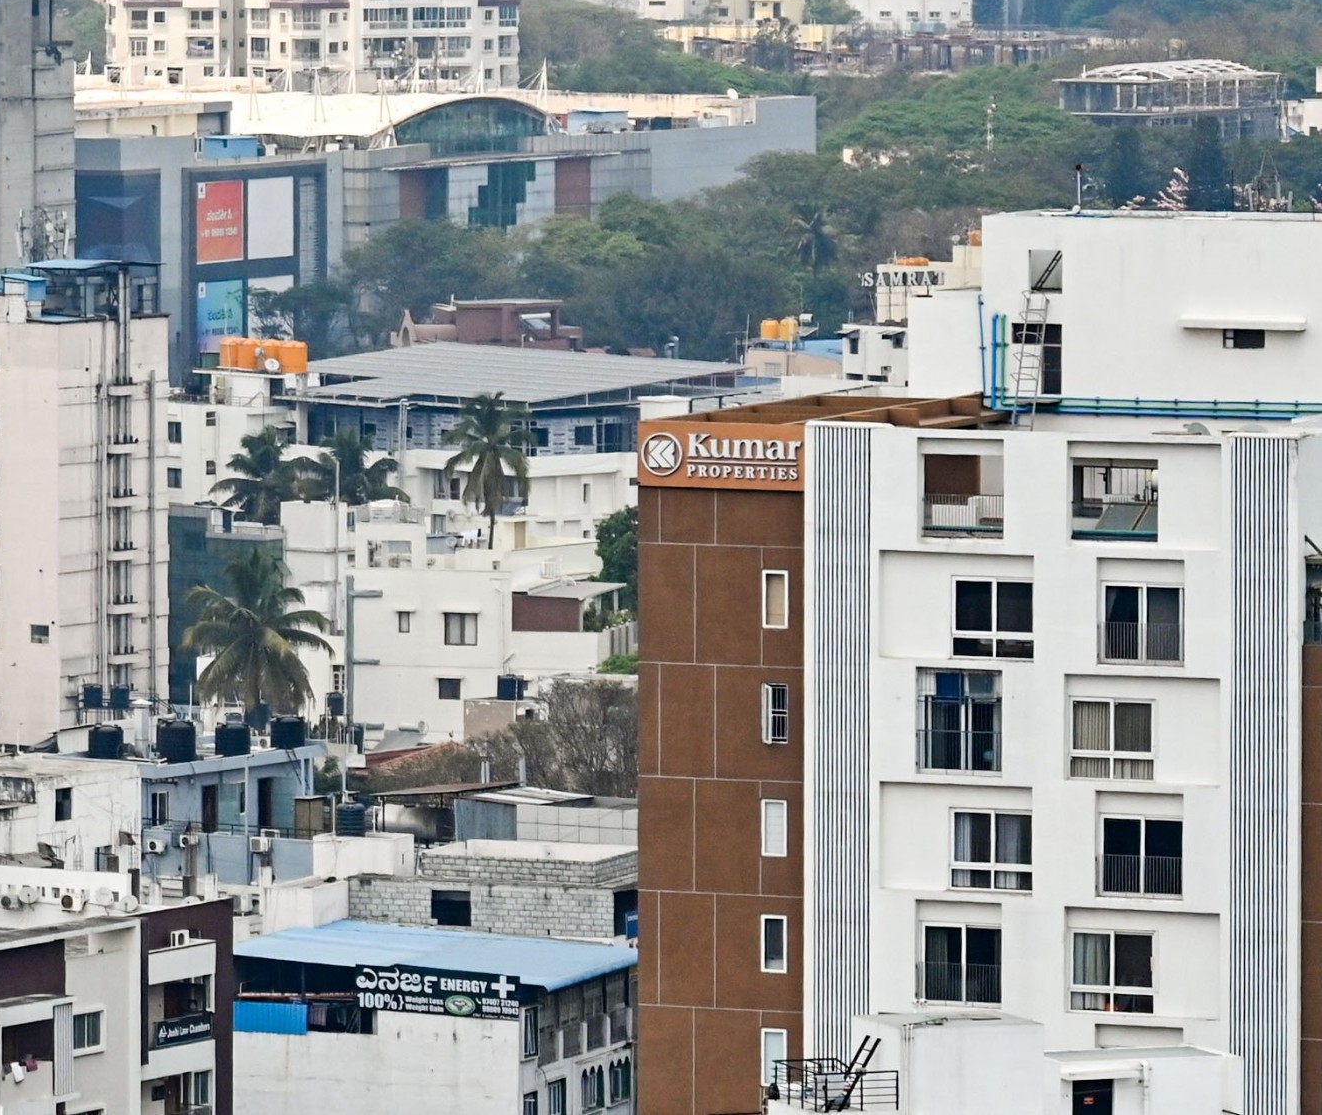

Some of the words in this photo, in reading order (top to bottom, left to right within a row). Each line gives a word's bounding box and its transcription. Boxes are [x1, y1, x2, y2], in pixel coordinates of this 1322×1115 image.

[863, 271, 945, 287] SAMRAT
[687, 433, 802, 461] Kumar
[687, 464, 799, 481] PROPERTIES
[440, 977, 488, 994] ENERGY
